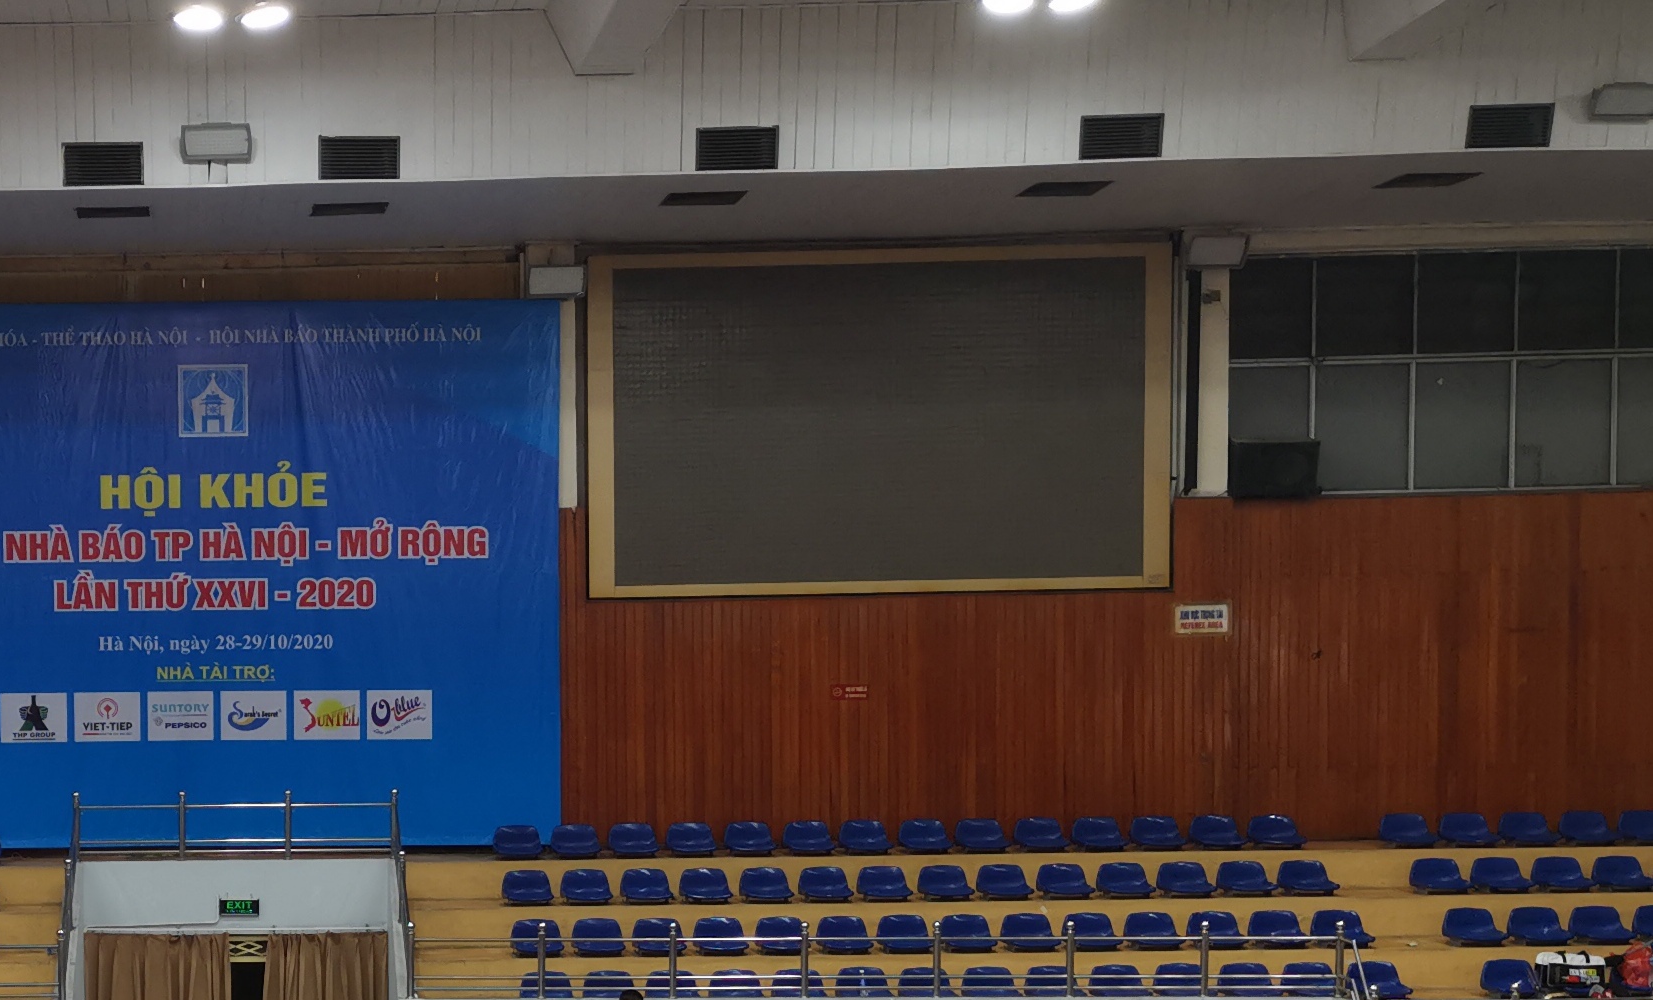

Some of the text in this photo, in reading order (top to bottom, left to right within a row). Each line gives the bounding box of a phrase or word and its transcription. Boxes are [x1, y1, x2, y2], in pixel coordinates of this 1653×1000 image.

[41, 325, 76, 346] THỂ
[79, 330, 126, 346] THAO
[130, 327, 153, 346] HÀ
[158, 325, 188, 348] NỘI
[209, 325, 241, 348] HỘI
[244, 325, 279, 344] NHÀ
[284, 325, 318, 344] BÁO
[322, 324, 380, 343] THÀNH
[384, 322, 419, 343] PHỐ
[423, 324, 447, 342] HÀ
[451, 323, 482, 345] NỘI
[100, 460, 328, 517] HỘI KHỎE
[3, 524, 74, 563] NHÀ
[78, 523, 146, 563] BÁO
[151, 529, 193, 562] TP
[199, 522, 247, 561] HÀ
[251, 521, 309, 567] NỘI
[337, 517, 393, 560] MỞ
[398, 519, 489, 565] RỘNG
[53, 569, 119, 612] LẦN
[124, 572, 191, 611] THỨ
[192, 577, 268, 611] XXVI
[296, 577, 376, 610] 2020
[98, 633, 334, 655] Hà Nội, ngày 28-29/10/2020
[156, 662, 275, 682] NHÀ TÀI TRỢ:
[152, 703, 210, 713] SUNTORY
[82, 721, 133, 732] VIET-TIEP
[165, 721, 207, 729] PEPSICO
[227, 901, 252, 909] EXIT
